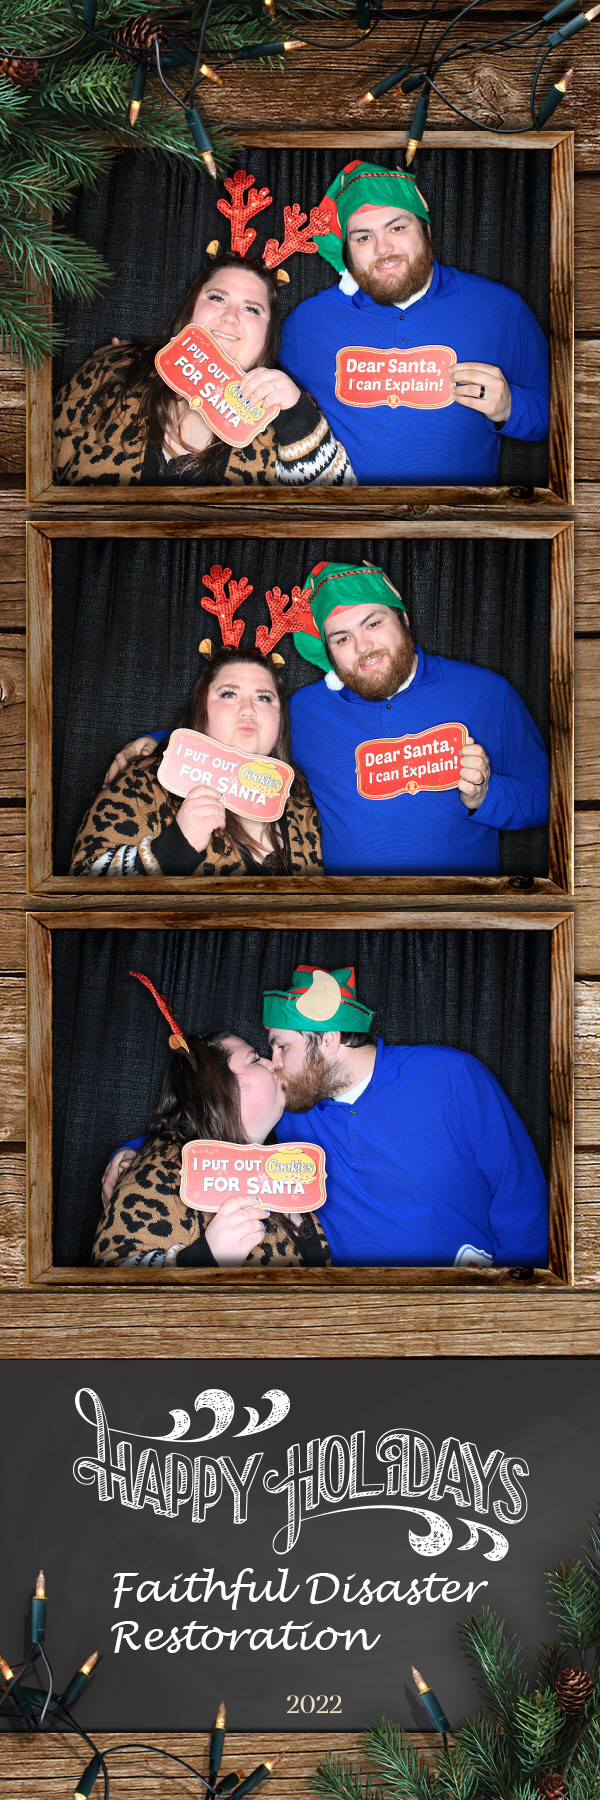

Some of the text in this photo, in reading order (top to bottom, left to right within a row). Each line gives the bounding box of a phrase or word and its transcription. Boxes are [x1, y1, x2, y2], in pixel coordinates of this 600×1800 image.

[181, 336, 192, 347] I
[187, 343, 210, 364] PUT
[207, 363, 230, 384] OUT
[346, 358, 442, 376] Dear Santa,
[174, 356, 241, 428] FOR SANTA
[348, 378, 444, 394] I can Explain!
[176, 744, 281, 789] I PUT OUT Cookies
[365, 739, 455, 767] Dear Santa,
[369, 756, 458, 784] I can Explain!
[180, 764, 267, 805] FOR SANTA
[193, 1157, 315, 1173] I PUT OUT Cookies
[203, 1177, 306, 1195] FOR SANTA
